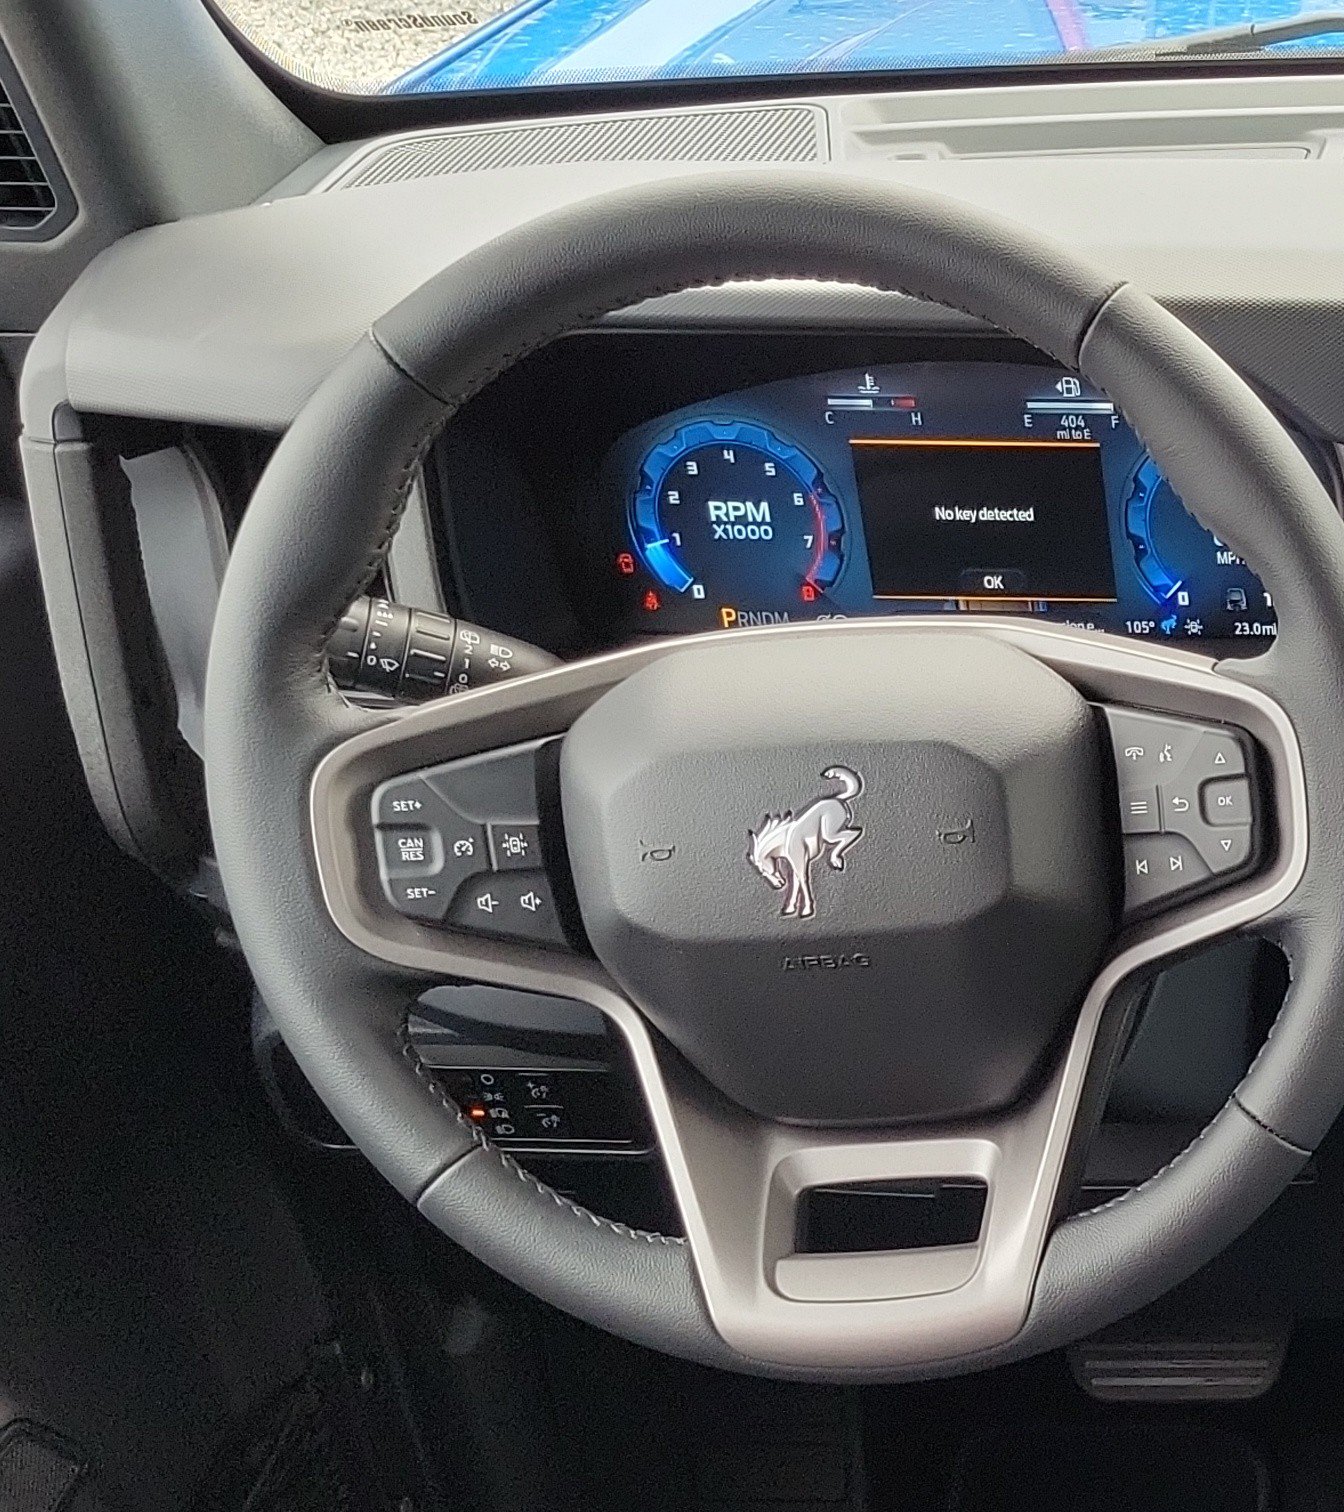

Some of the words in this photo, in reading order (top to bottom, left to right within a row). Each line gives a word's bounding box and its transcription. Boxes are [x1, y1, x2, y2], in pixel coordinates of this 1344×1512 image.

[825, 412, 834, 425] C
[911, 412, 923, 426] H
[1023, 414, 1033, 427] E
[1060, 415, 1085, 428] 404
[1111, 415, 1120, 429] F
[1071, 429, 1083, 440] to
[1083, 429, 1091, 440] E
[723, 450, 735, 463] 4
[686, 461, 698, 475] 3
[764, 462, 776, 476] 5
[668, 490, 680, 504] 2
[793, 492, 805, 506] 6
[708, 500, 771, 522] RPM
[934, 506, 953, 521] No
[954, 506, 977, 523] key
[979, 506, 1035, 521] detected
[713, 524, 773, 540] X1000
[671, 533, 682, 547] 1
[803, 535, 813, 549] 7
[983, 575, 1004, 589] OK
[692, 584, 706, 599] 0
[1177, 591, 1190, 605] 0
[1126, 620, 1155, 634] 105°
[1217, 796, 1233, 806] OK
[398, 837, 424, 849] CAN
[401, 851, 424, 861] RES
[783, 953, 870, 971] AIRBAG
